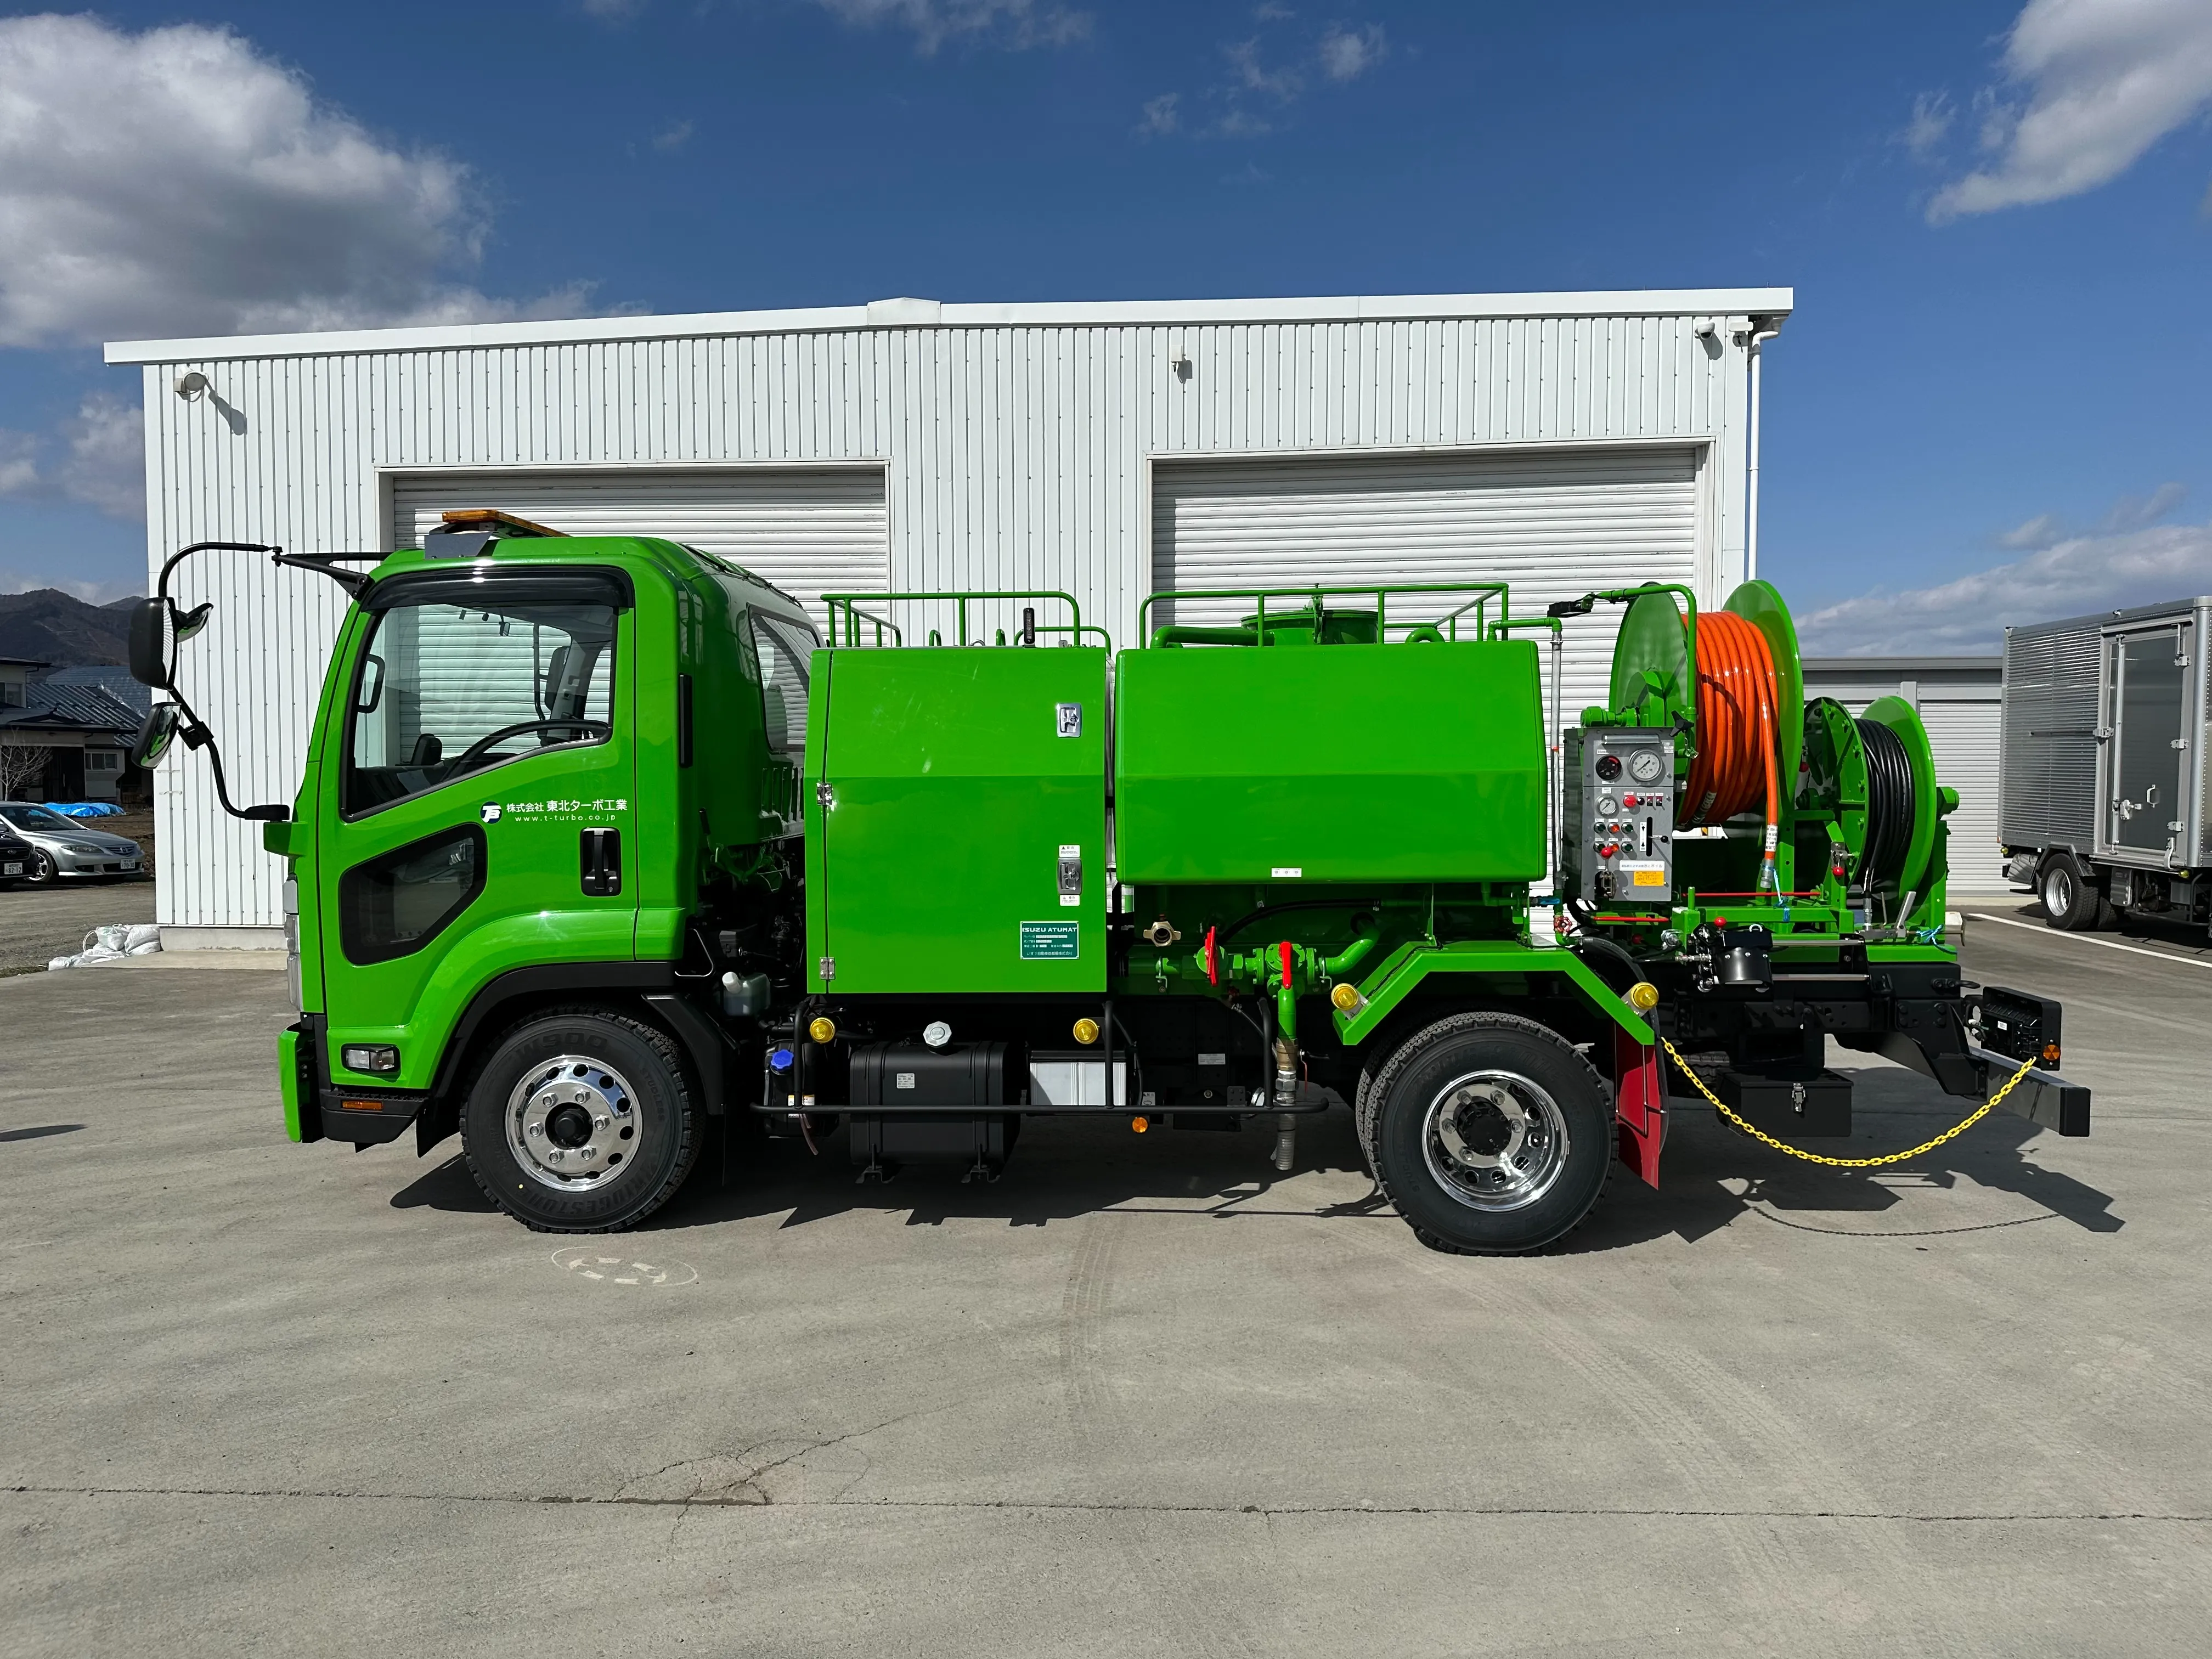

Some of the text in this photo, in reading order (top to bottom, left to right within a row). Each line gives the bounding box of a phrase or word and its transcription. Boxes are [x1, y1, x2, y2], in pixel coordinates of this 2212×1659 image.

[506, 799, 628, 813] 株式会社 東北ターボ工業
[515, 814, 616, 822] www.t-turbo.co.jp
